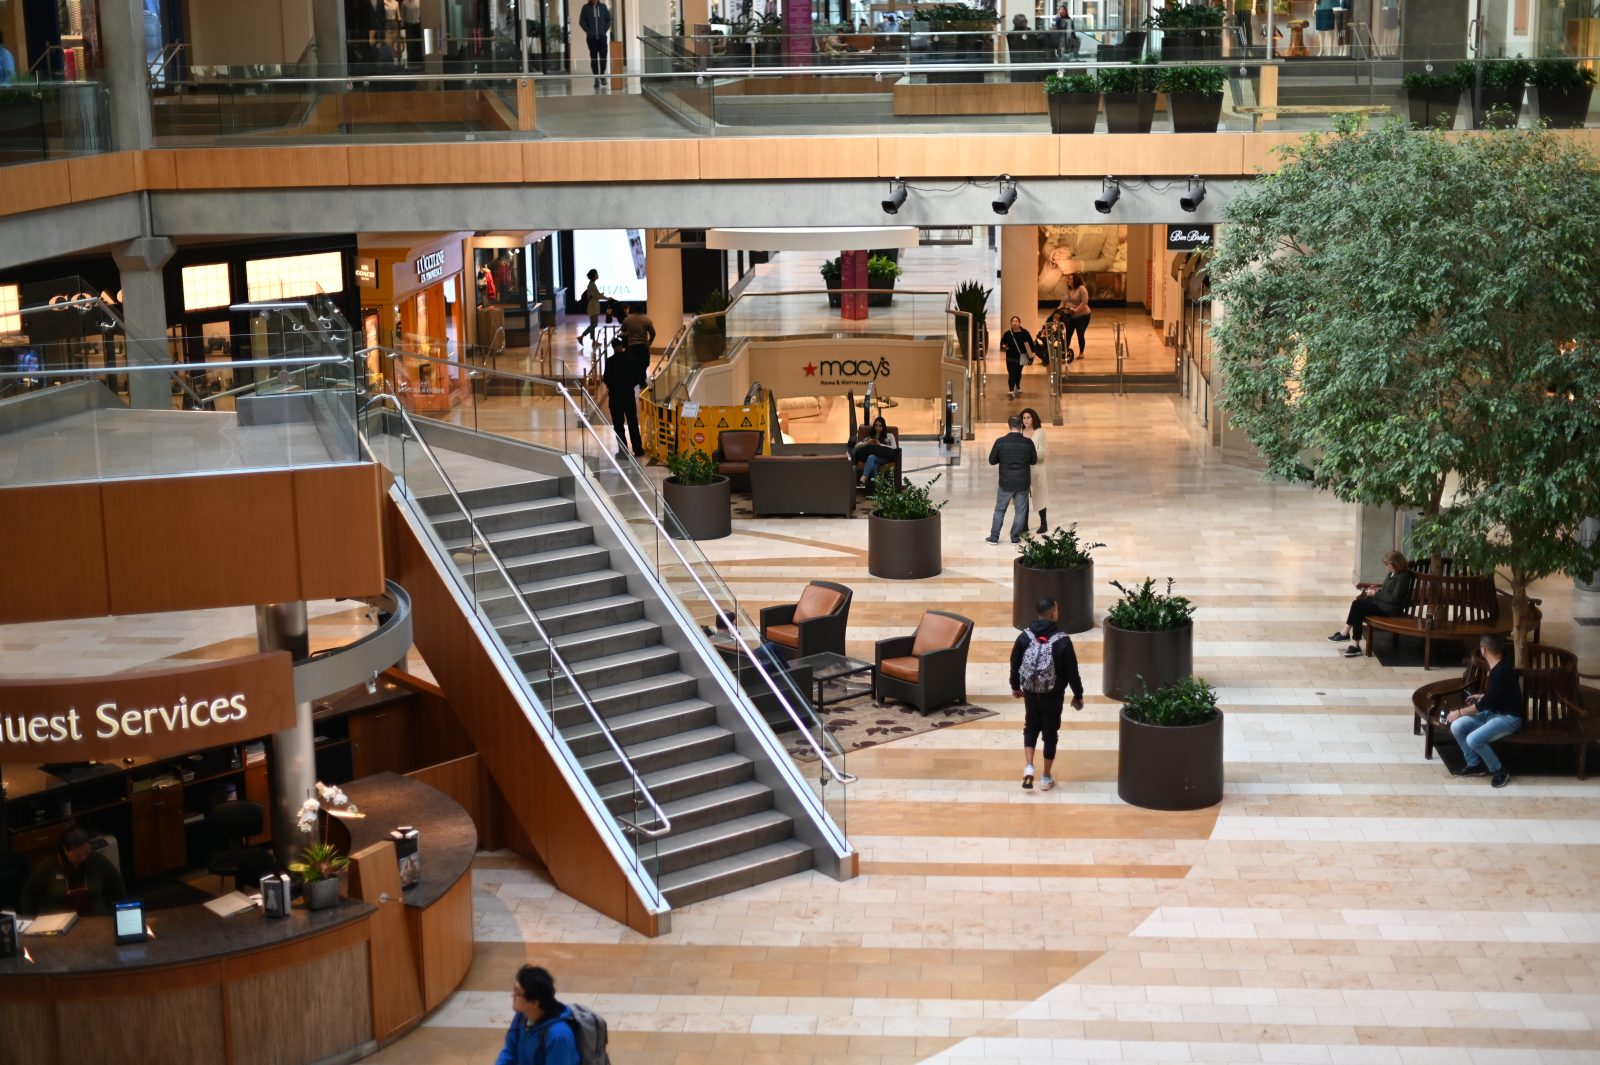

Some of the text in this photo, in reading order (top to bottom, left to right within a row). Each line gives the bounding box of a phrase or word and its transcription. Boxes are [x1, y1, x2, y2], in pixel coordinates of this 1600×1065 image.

[1170, 230, 1187, 241] Ben
[49, 289, 124, 311] COA
[820, 356, 890, 380] macy's
[0, 693, 248, 743] uest Services
